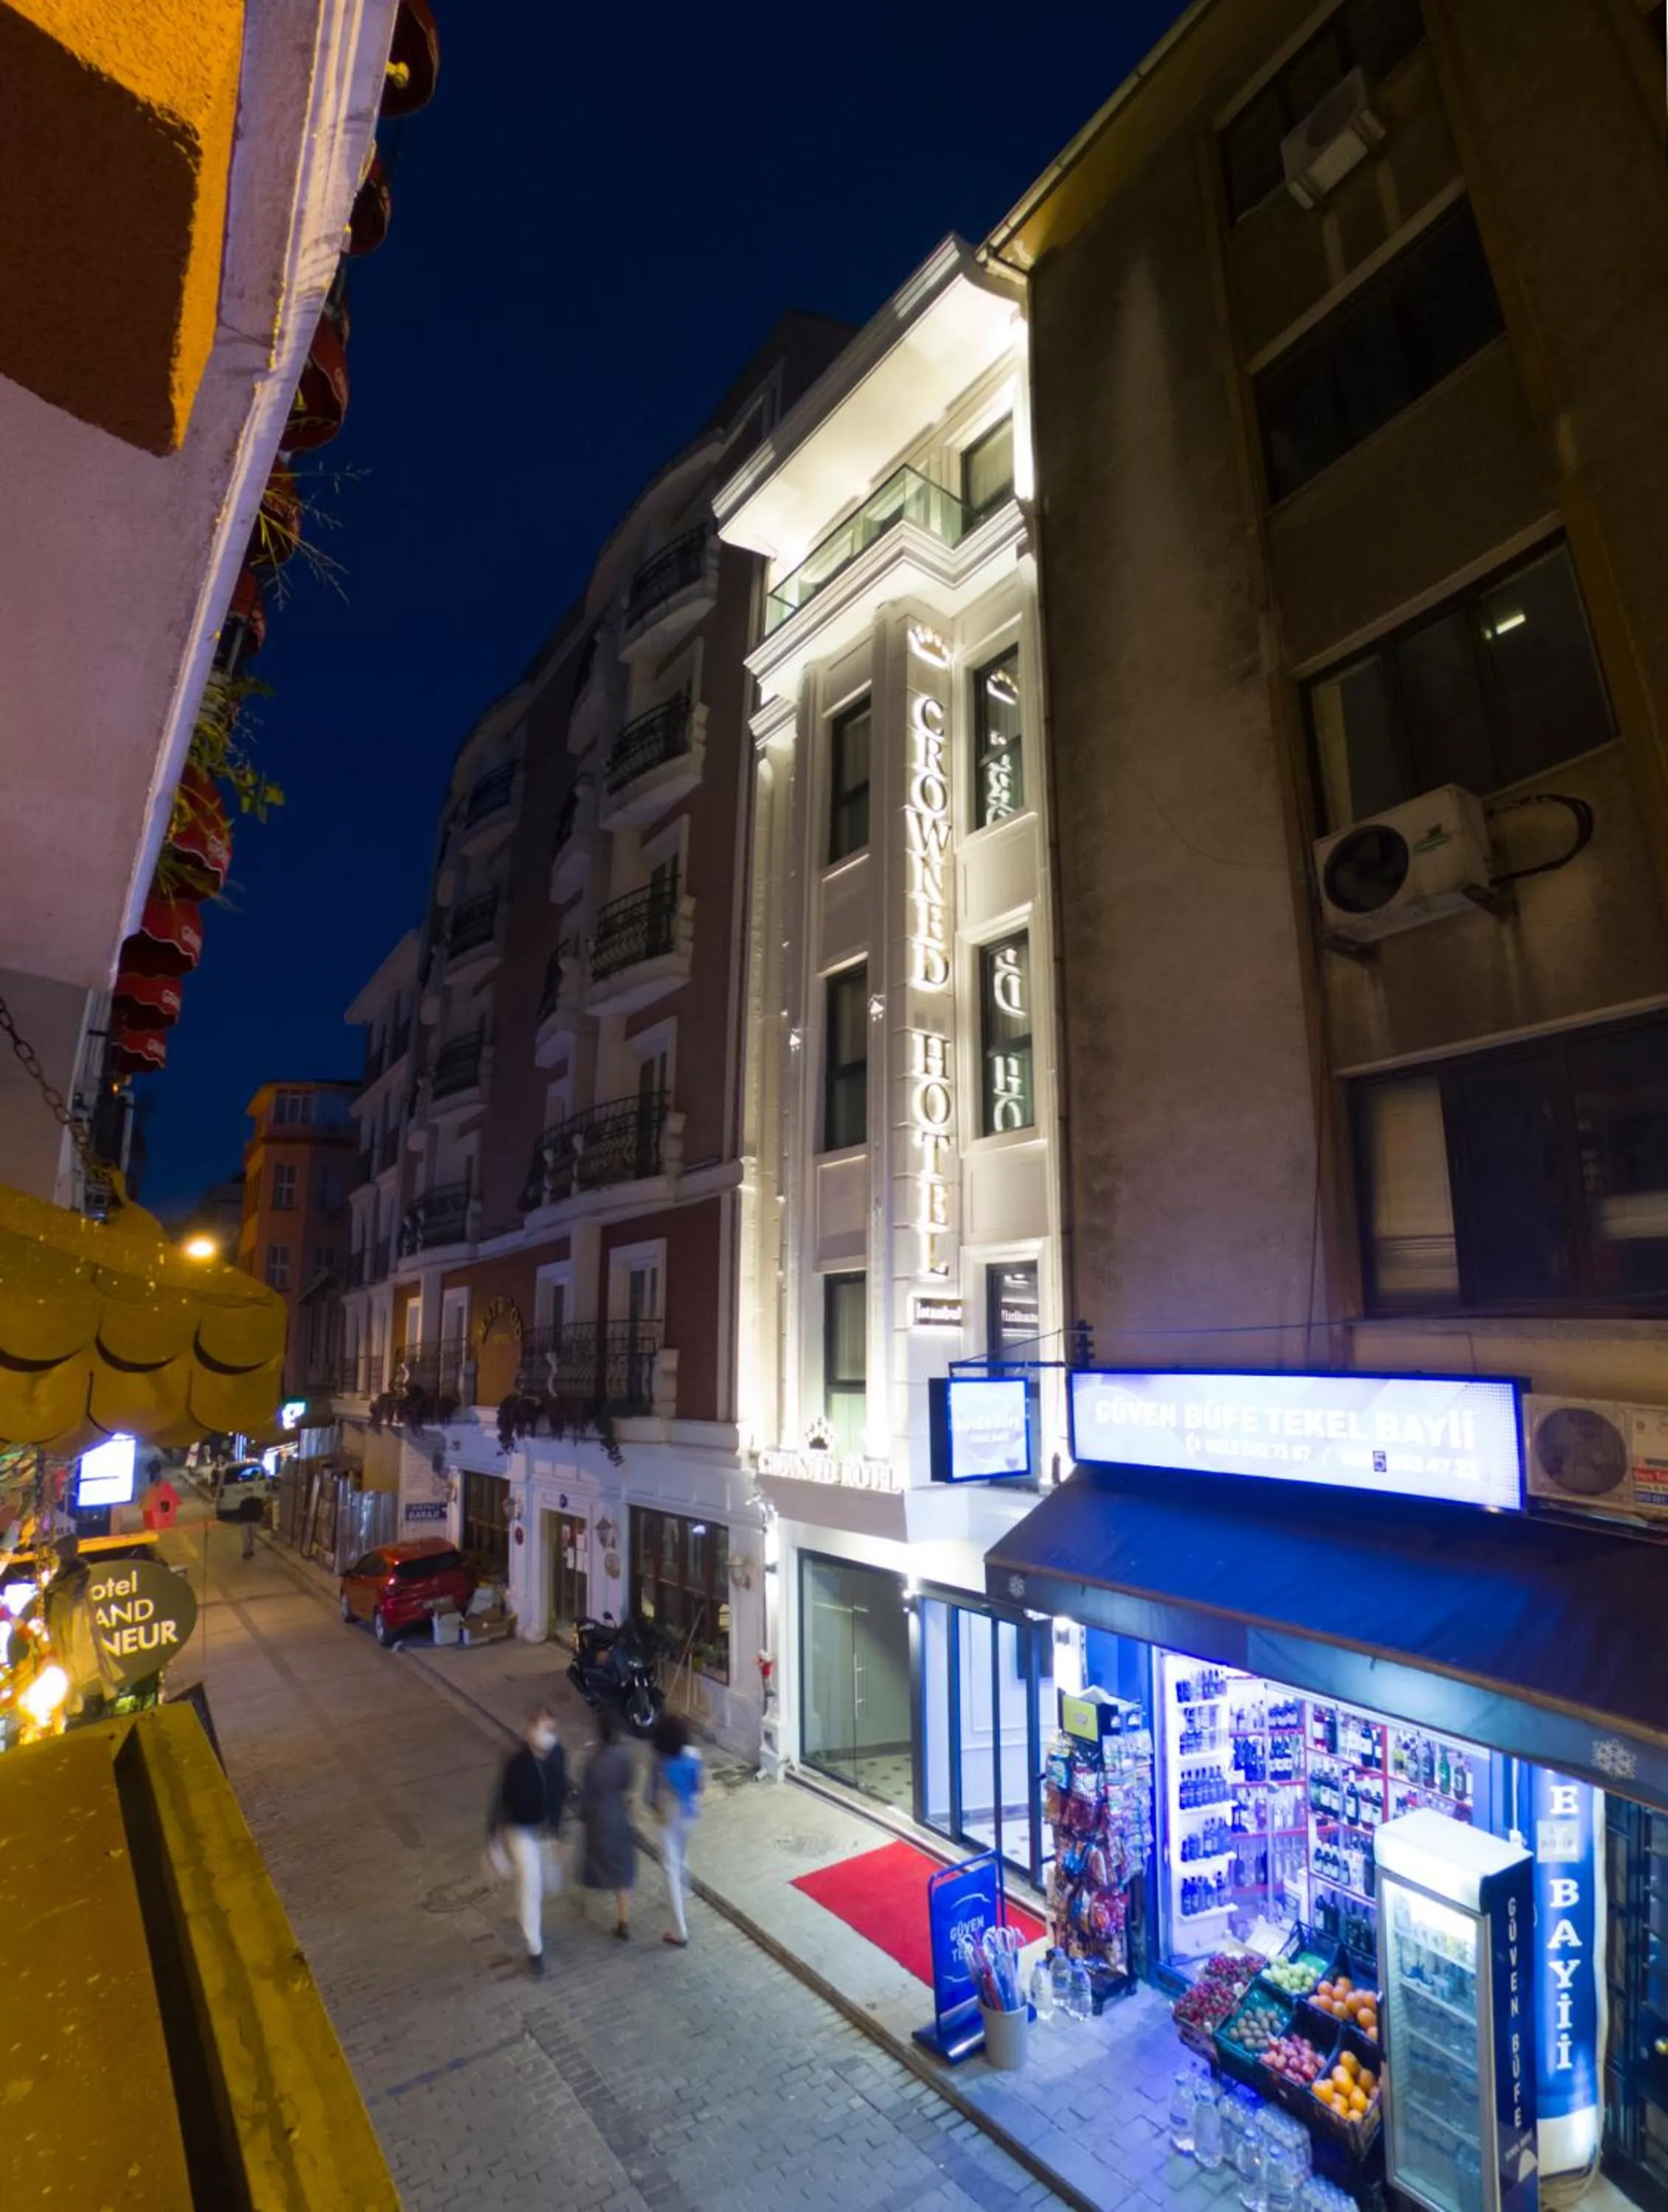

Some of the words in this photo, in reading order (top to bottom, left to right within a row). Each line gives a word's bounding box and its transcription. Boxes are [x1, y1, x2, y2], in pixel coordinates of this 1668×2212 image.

[907, 695, 952, 989] CROWNED
[912, 1034, 951, 1280] HOTEL
[1096, 1396, 1176, 1428] GÜVEN
[1185, 1399, 1258, 1433] BÜFE
[1265, 1405, 1369, 1441] TEKEL
[91, 1570, 137, 1601] otel
[96, 1599, 154, 1628] AND
[1507, 1897, 1519, 2017] GÜVEN
[1547, 1879, 1583, 2070] BAYİİ
[1512, 2033, 1522, 2128] BÜFE
